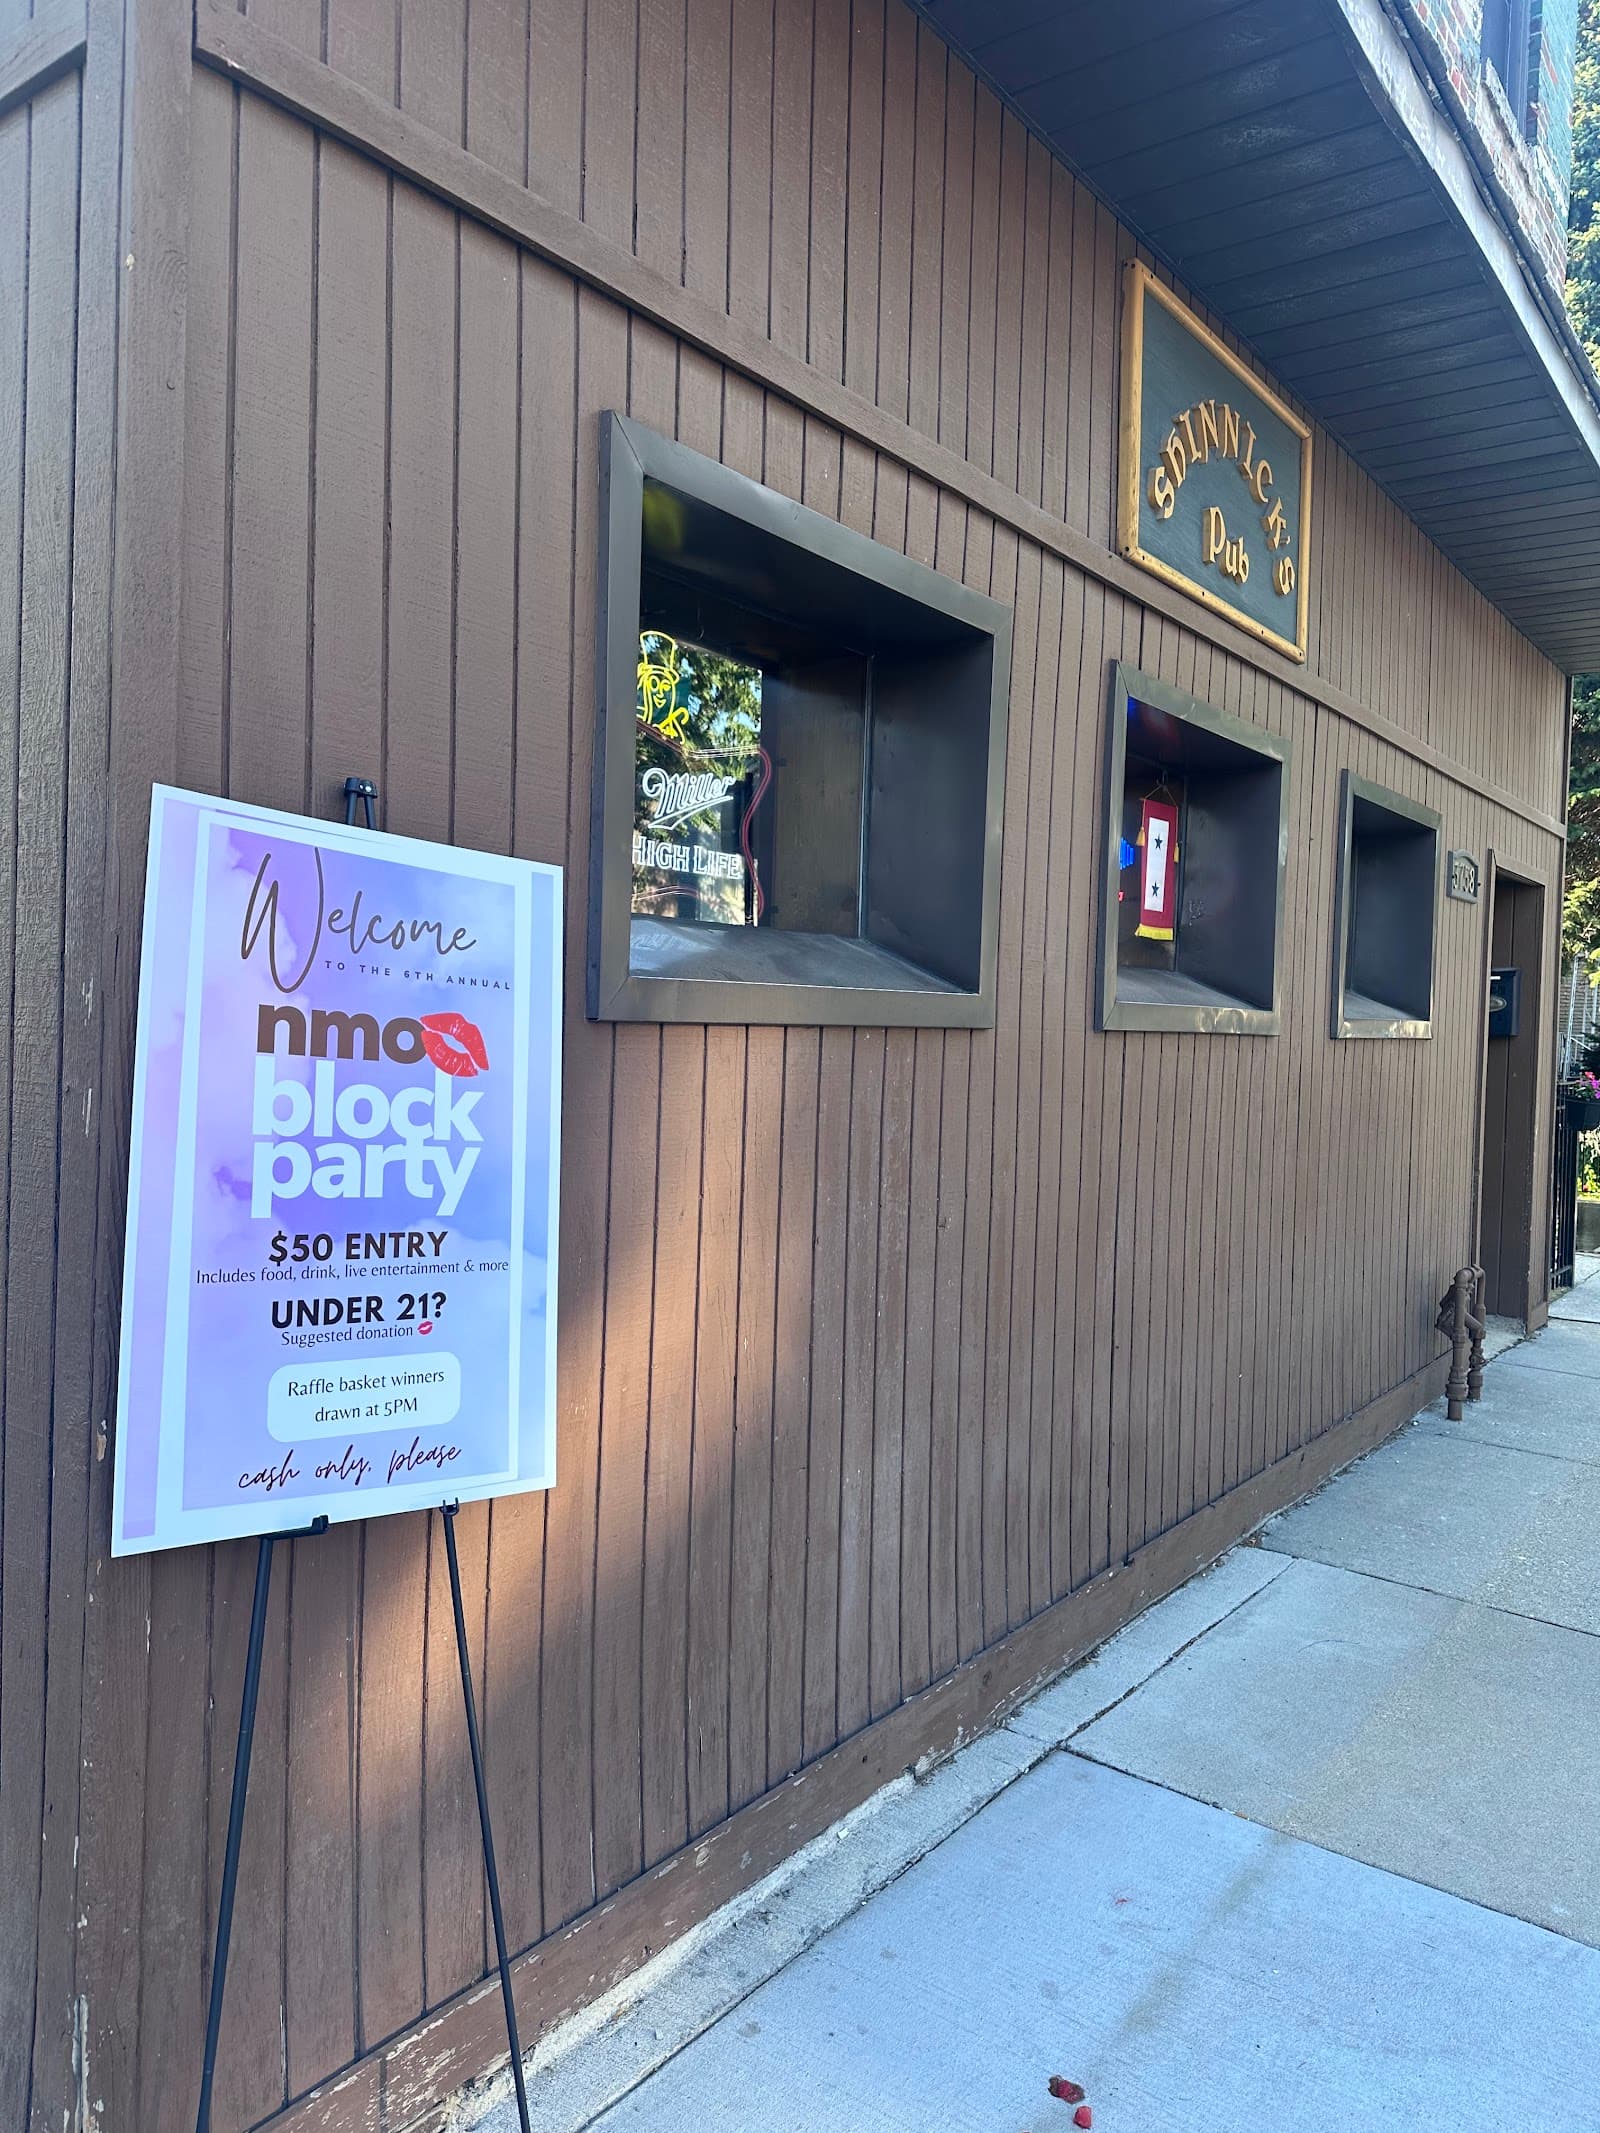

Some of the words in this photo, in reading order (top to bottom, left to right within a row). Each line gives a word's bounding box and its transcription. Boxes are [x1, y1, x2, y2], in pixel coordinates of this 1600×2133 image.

[1202, 506, 1249, 584] Pub
[642, 767, 736, 819] Miller
[632, 836, 690, 873] HIGH
[693, 845, 743, 880] LIFE
[241, 847, 476, 993] Welcome
[325, 960, 346, 971] TO
[360, 964, 391, 977] THE
[404, 970, 434, 982] 6TH
[446, 975, 511, 990] ANNUAL
[256, 1004, 426, 1064] nmo
[252, 1055, 485, 1141] block
[251, 1138, 480, 1219] party
[269, 1230, 333, 1267] $50
[345, 1231, 448, 1260] ENTRY
[196, 1268, 256, 1284] Includes
[260, 1265, 296, 1282] food,
[301, 1263, 339, 1281] drink,
[345, 1262, 367, 1279] live
[371, 1259, 460, 1276] entertainment
[463, 1258, 475, 1273] &
[479, 1260, 509, 1273] more
[272, 1296, 385, 1328] UNDER
[396, 1292, 447, 1320] 21?
[281, 1326, 352, 1349] Suggested
[356, 1325, 414, 1341] donation
[288, 1378, 334, 1397] Raffle
[338, 1373, 386, 1393] basket
[391, 1368, 445, 1388] winners
[314, 1404, 361, 1423] drawn
[365, 1403, 379, 1418] at
[383, 1398, 418, 1418] 5PM
[238, 1449, 300, 1492] cash
[387, 1436, 462, 1484] please
